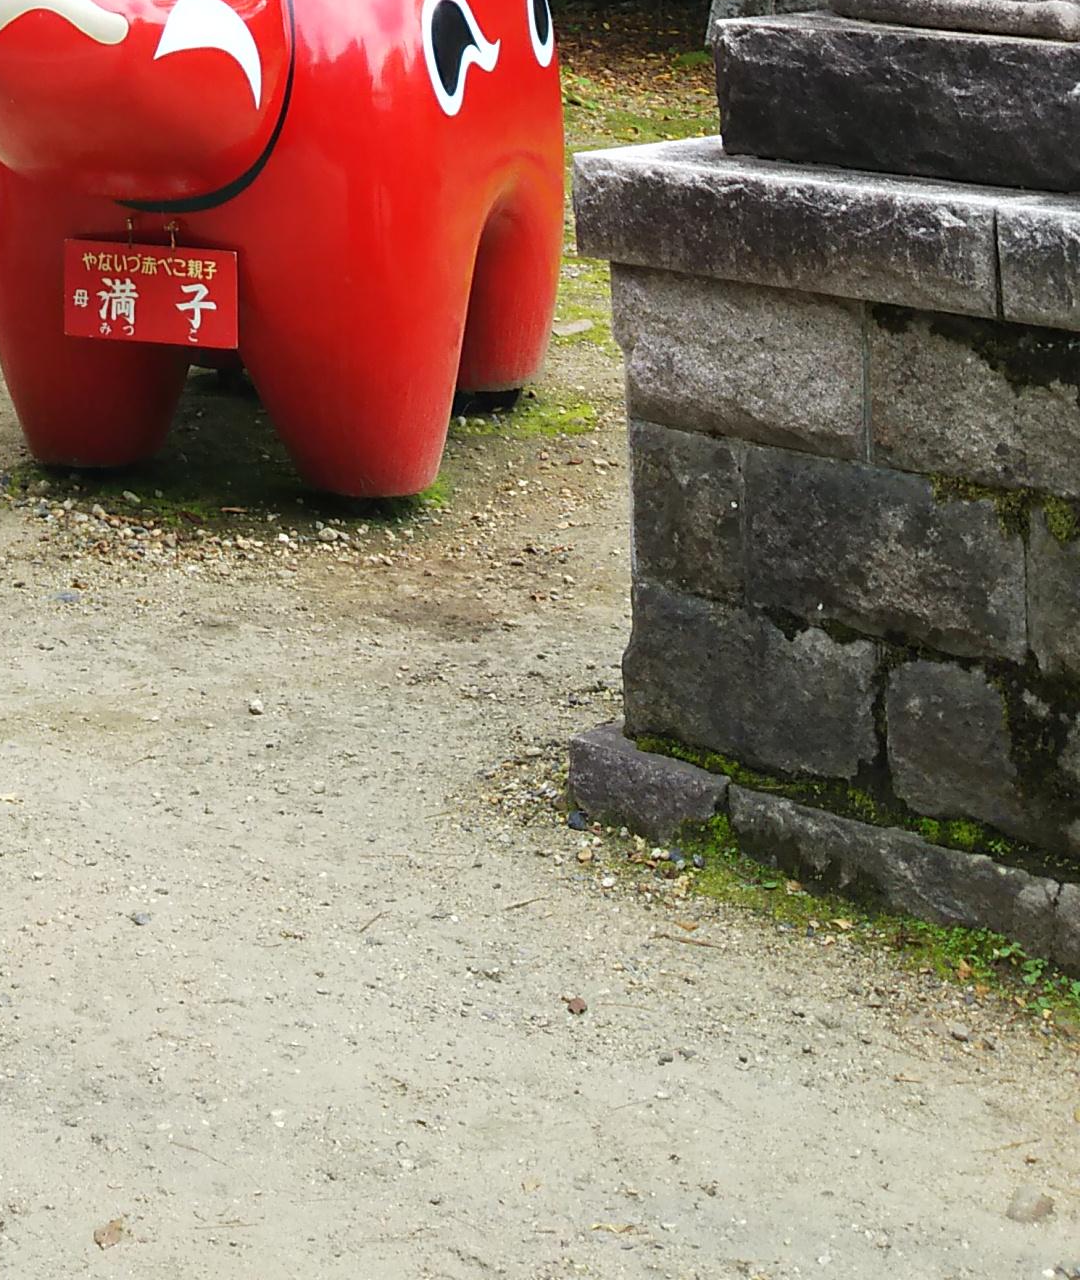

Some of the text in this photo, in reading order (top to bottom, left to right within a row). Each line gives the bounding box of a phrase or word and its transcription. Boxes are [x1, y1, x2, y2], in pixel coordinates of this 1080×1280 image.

[82, 252, 218, 280] やないづ赤べこ親子
[73, 289, 89, 308] 母
